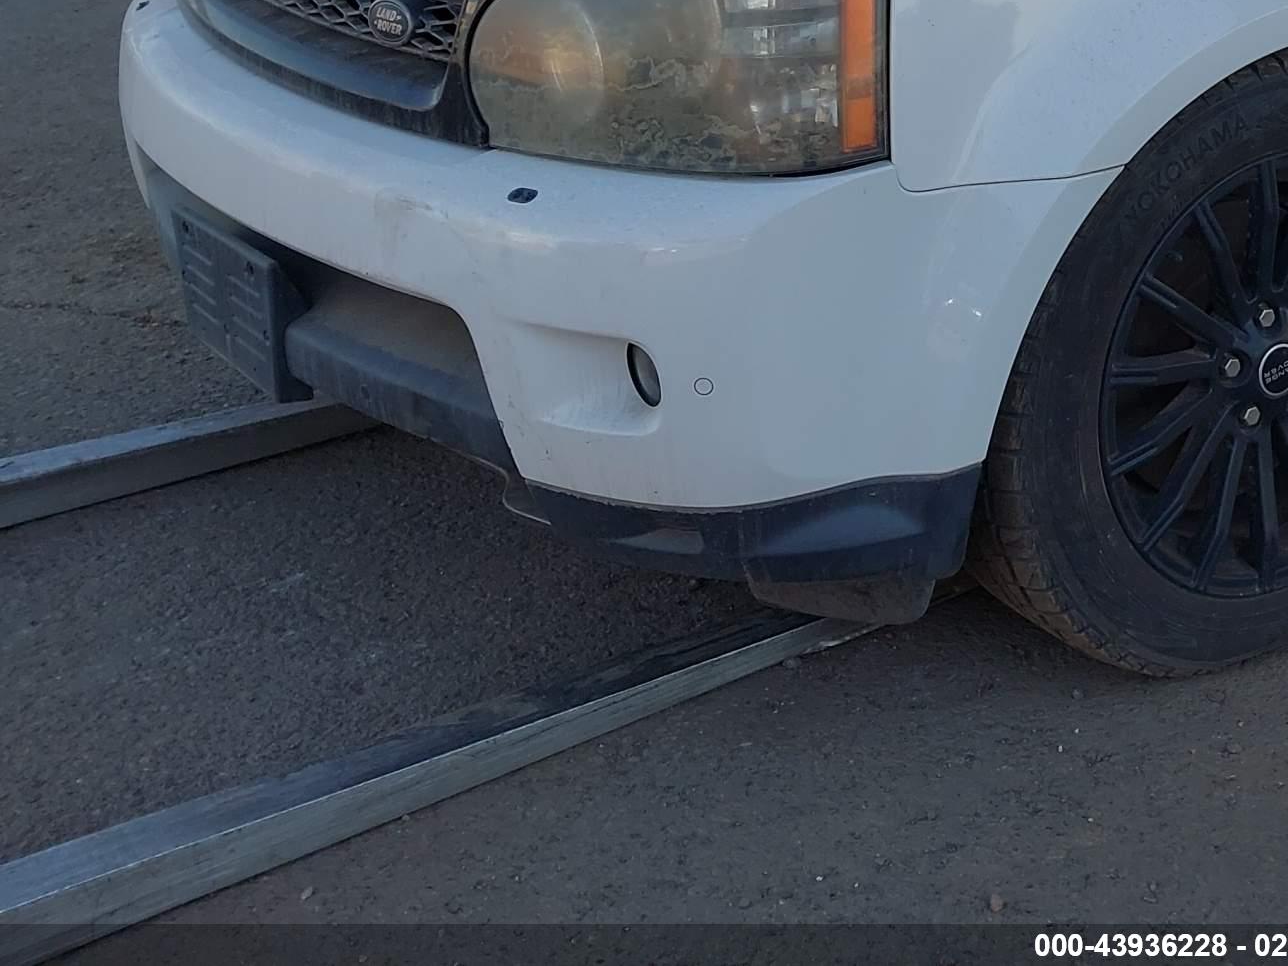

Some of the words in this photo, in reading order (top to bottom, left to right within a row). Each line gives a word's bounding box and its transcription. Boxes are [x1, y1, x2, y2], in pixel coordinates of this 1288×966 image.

[376, 6, 397, 22] LAND
[377, 19, 402, 36] ROVER
[1123, 111, 1250, 221] YOKOHAMA
